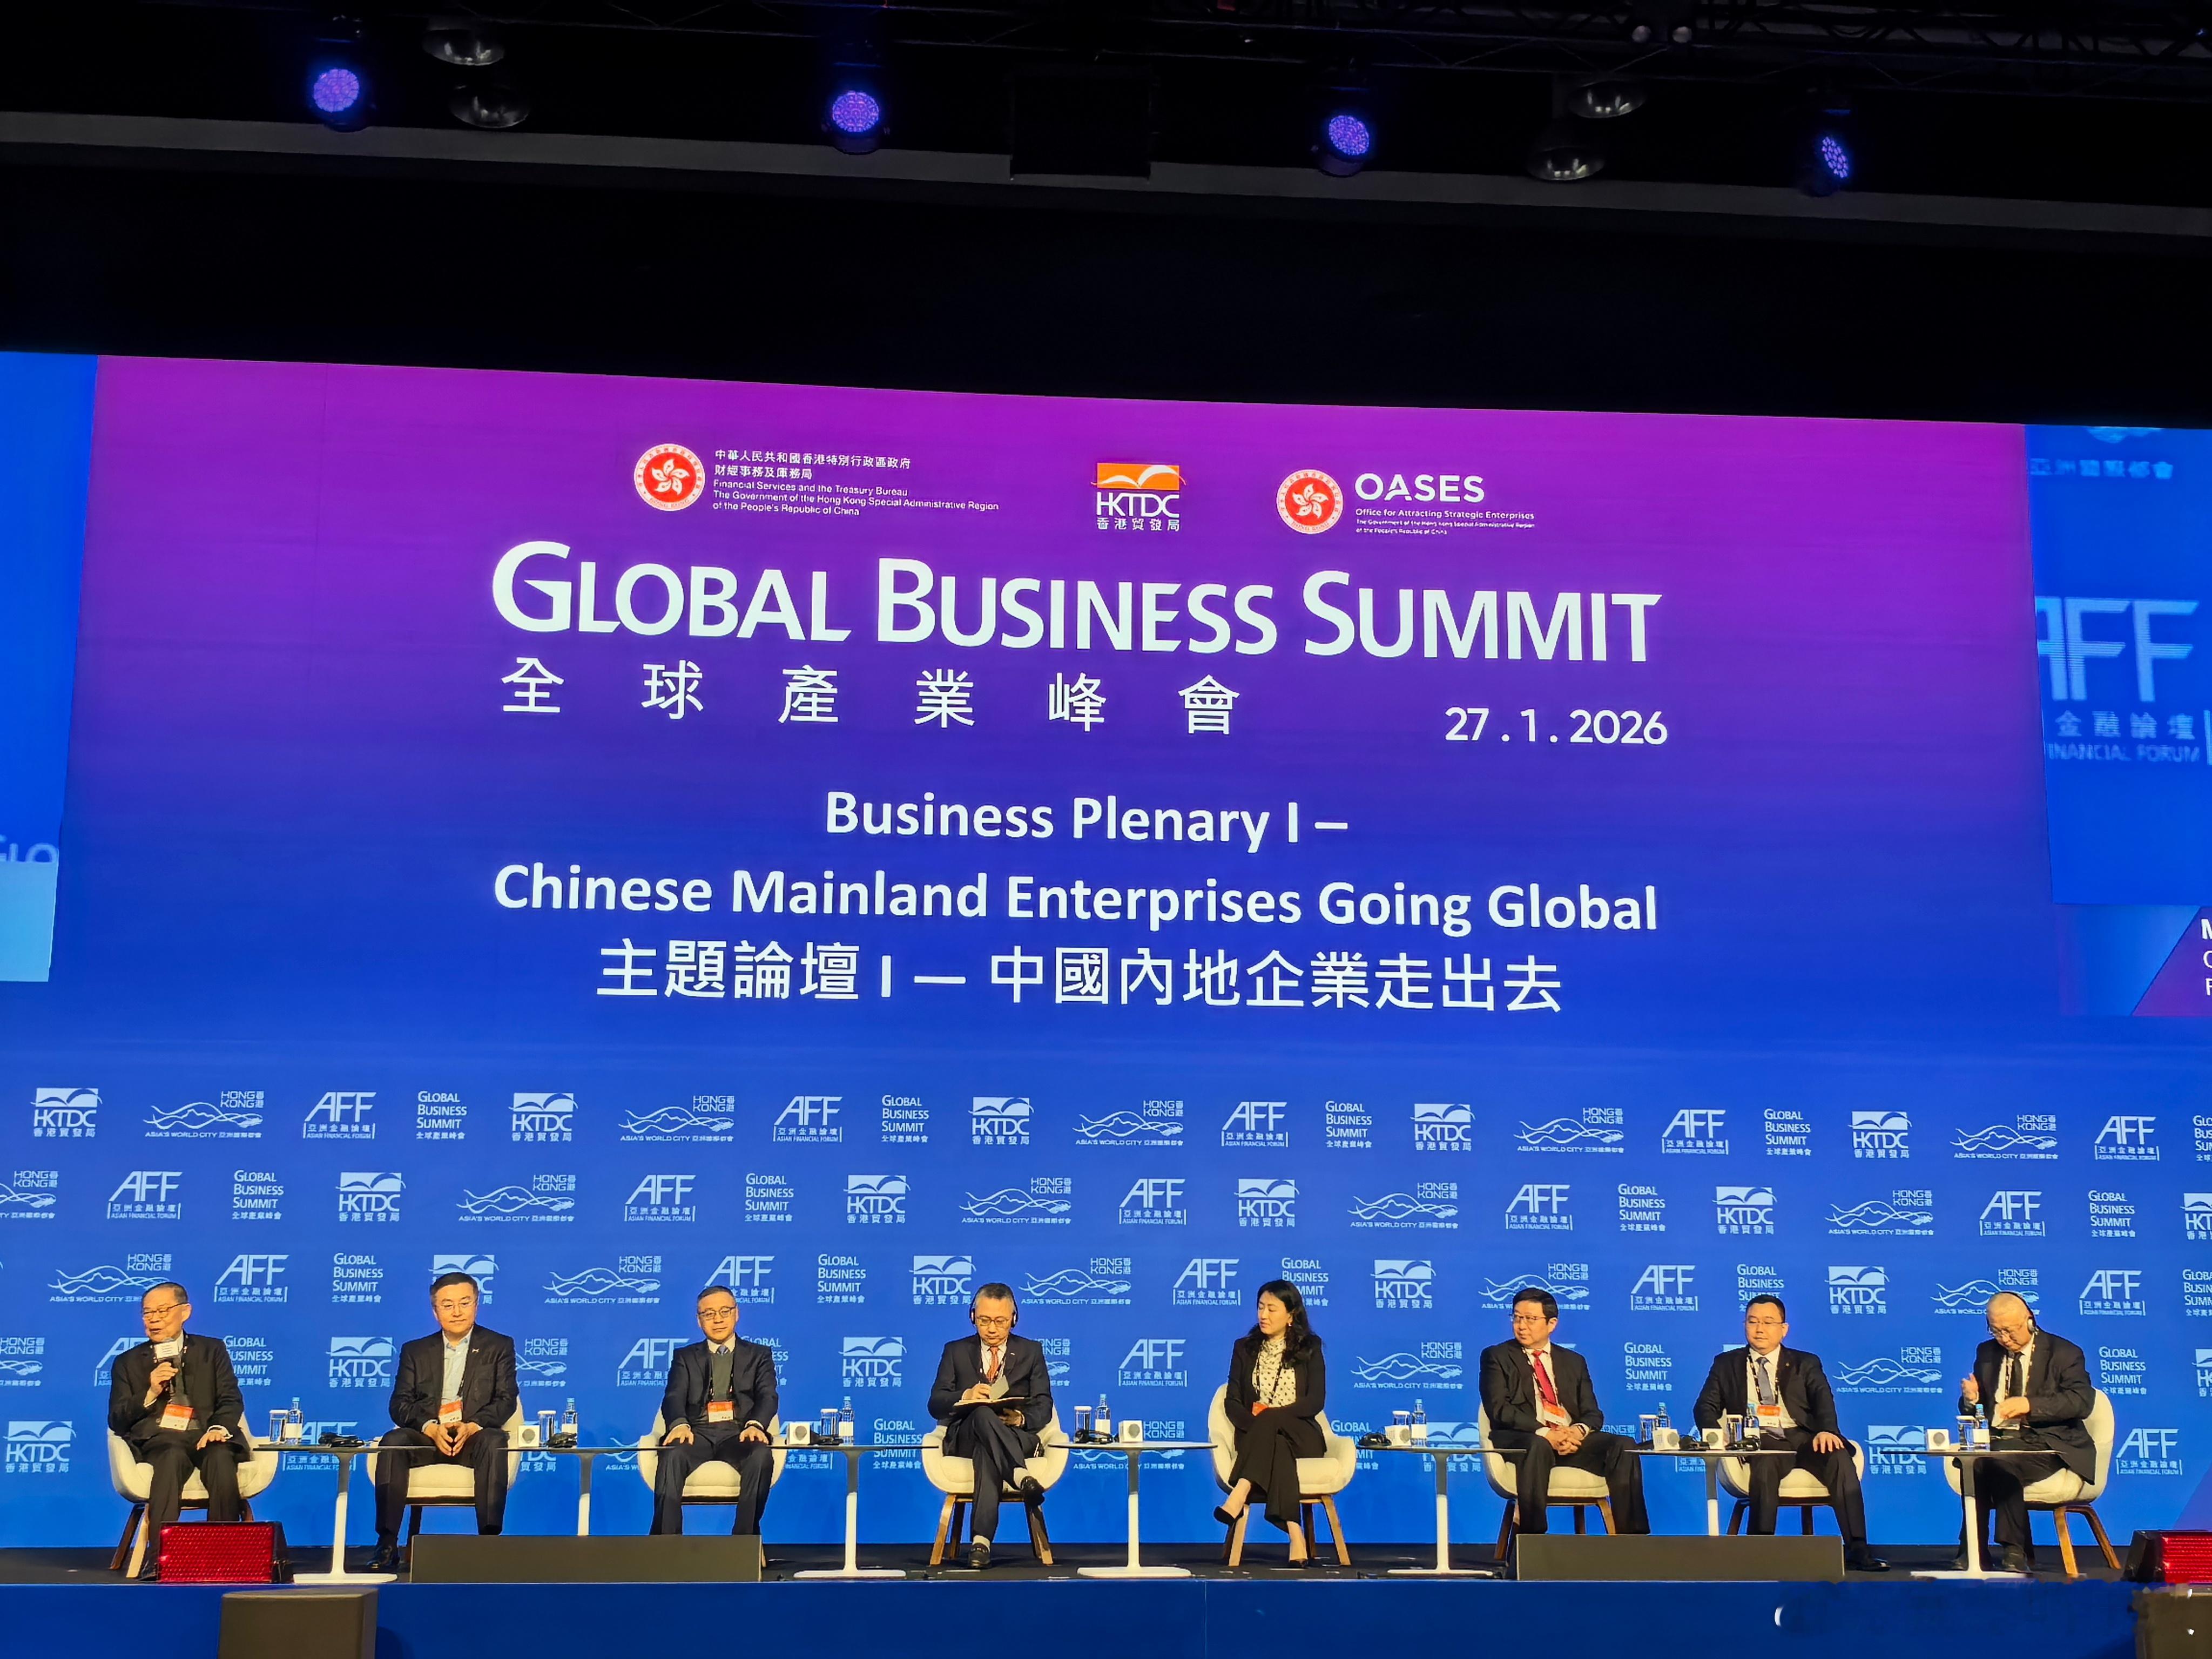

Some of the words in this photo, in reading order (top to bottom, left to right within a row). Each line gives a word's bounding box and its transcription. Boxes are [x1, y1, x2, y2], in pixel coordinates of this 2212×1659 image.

[713, 479, 754, 489] Financial
[757, 481, 796, 491] Services
[799, 484, 815, 492] and
[818, 484, 832, 493] the
[835, 485, 873, 496] Treasury
[876, 487, 907, 496] Bureau
[713, 490, 730, 498] The
[732, 491, 787, 501] Government
[790, 493, 799, 502] of
[817, 495, 841, 505] Hong
[843, 496, 866, 507] Kong
[868, 497, 901, 507] Special
[903, 499, 966, 509] Administrative
[968, 501, 999, 511] Region
[1355, 474, 1484, 502] OASES
[741, 502, 779, 512] People's
[781, 504, 820, 514] Republic
[834, 507, 860, 515] China
[1096, 491, 1180, 518] HKTDC
[1398, 510, 1442, 518] Attracting
[1445, 510, 1483, 519] Strategic
[1486, 511, 1534, 520] Enterprises
[1097, 517, 1180, 532] 香港貿發局
[501, 657, 1240, 734] 全球產業峰會
[827, 792, 1053, 838] Business
[1074, 795, 1270, 853] Plenary
[495, 862, 712, 912] Chinese
[733, 870, 987, 917] Mainland
[1009, 876, 1301, 931] Enterprises
[1319, 882, 1471, 937] Going
[1489, 884, 1656, 929] Global
[597, 938, 859, 999] 主題論壇
[992, 946, 1561, 1012] 中國內地企業走出去
[34, 1110, 96, 1127] HKTDC
[305, 1092, 376, 1122] AFF
[774, 1096, 842, 1125] AFF
[1222, 1102, 1287, 1131] AFF
[512, 1114, 572, 1131] HKTDC
[973, 1118, 1029, 1135] HKTDC
[1415, 1124, 1471, 1141] HKTDC
[1662, 1110, 1725, 1138] AFF
[2095, 1116, 2156, 1144] AFF
[1853, 1132, 1908, 1148] HKTDC
[109, 1171, 182, 1202] AFF
[625, 1175, 696, 1204] AFF
[1120, 1179, 1185, 1208] AFF
[1506, 1185, 1570, 1213] AFF
[339, 1194, 400, 1211] HKTDC
[847, 1196, 905, 1213] HKTDC
[1239, 1200, 1294, 1217] HKTDC
[1717, 1208, 1773, 1224] HKTDC
[1980, 1191, 2042, 1220] AFF
[216, 1255, 289, 1285] AFF
[705, 1256, 774, 1286] AFF
[1174, 1259, 1239, 1289] AFF
[1631, 1265, 1695, 1294] AFF
[913, 1277, 972, 1294] HKTDC
[1375, 1281, 1432, 1298] HKTDC
[1830, 1287, 1886, 1304] HKTDC
[2080, 1270, 2142, 1299] AFF
[842, 1359, 901, 1377] HKTDC
[1119, 1339, 1186, 1369] AFF
[6, 1444, 70, 1462] HKTDC
[2116, 1428, 2179, 1458] AFF
